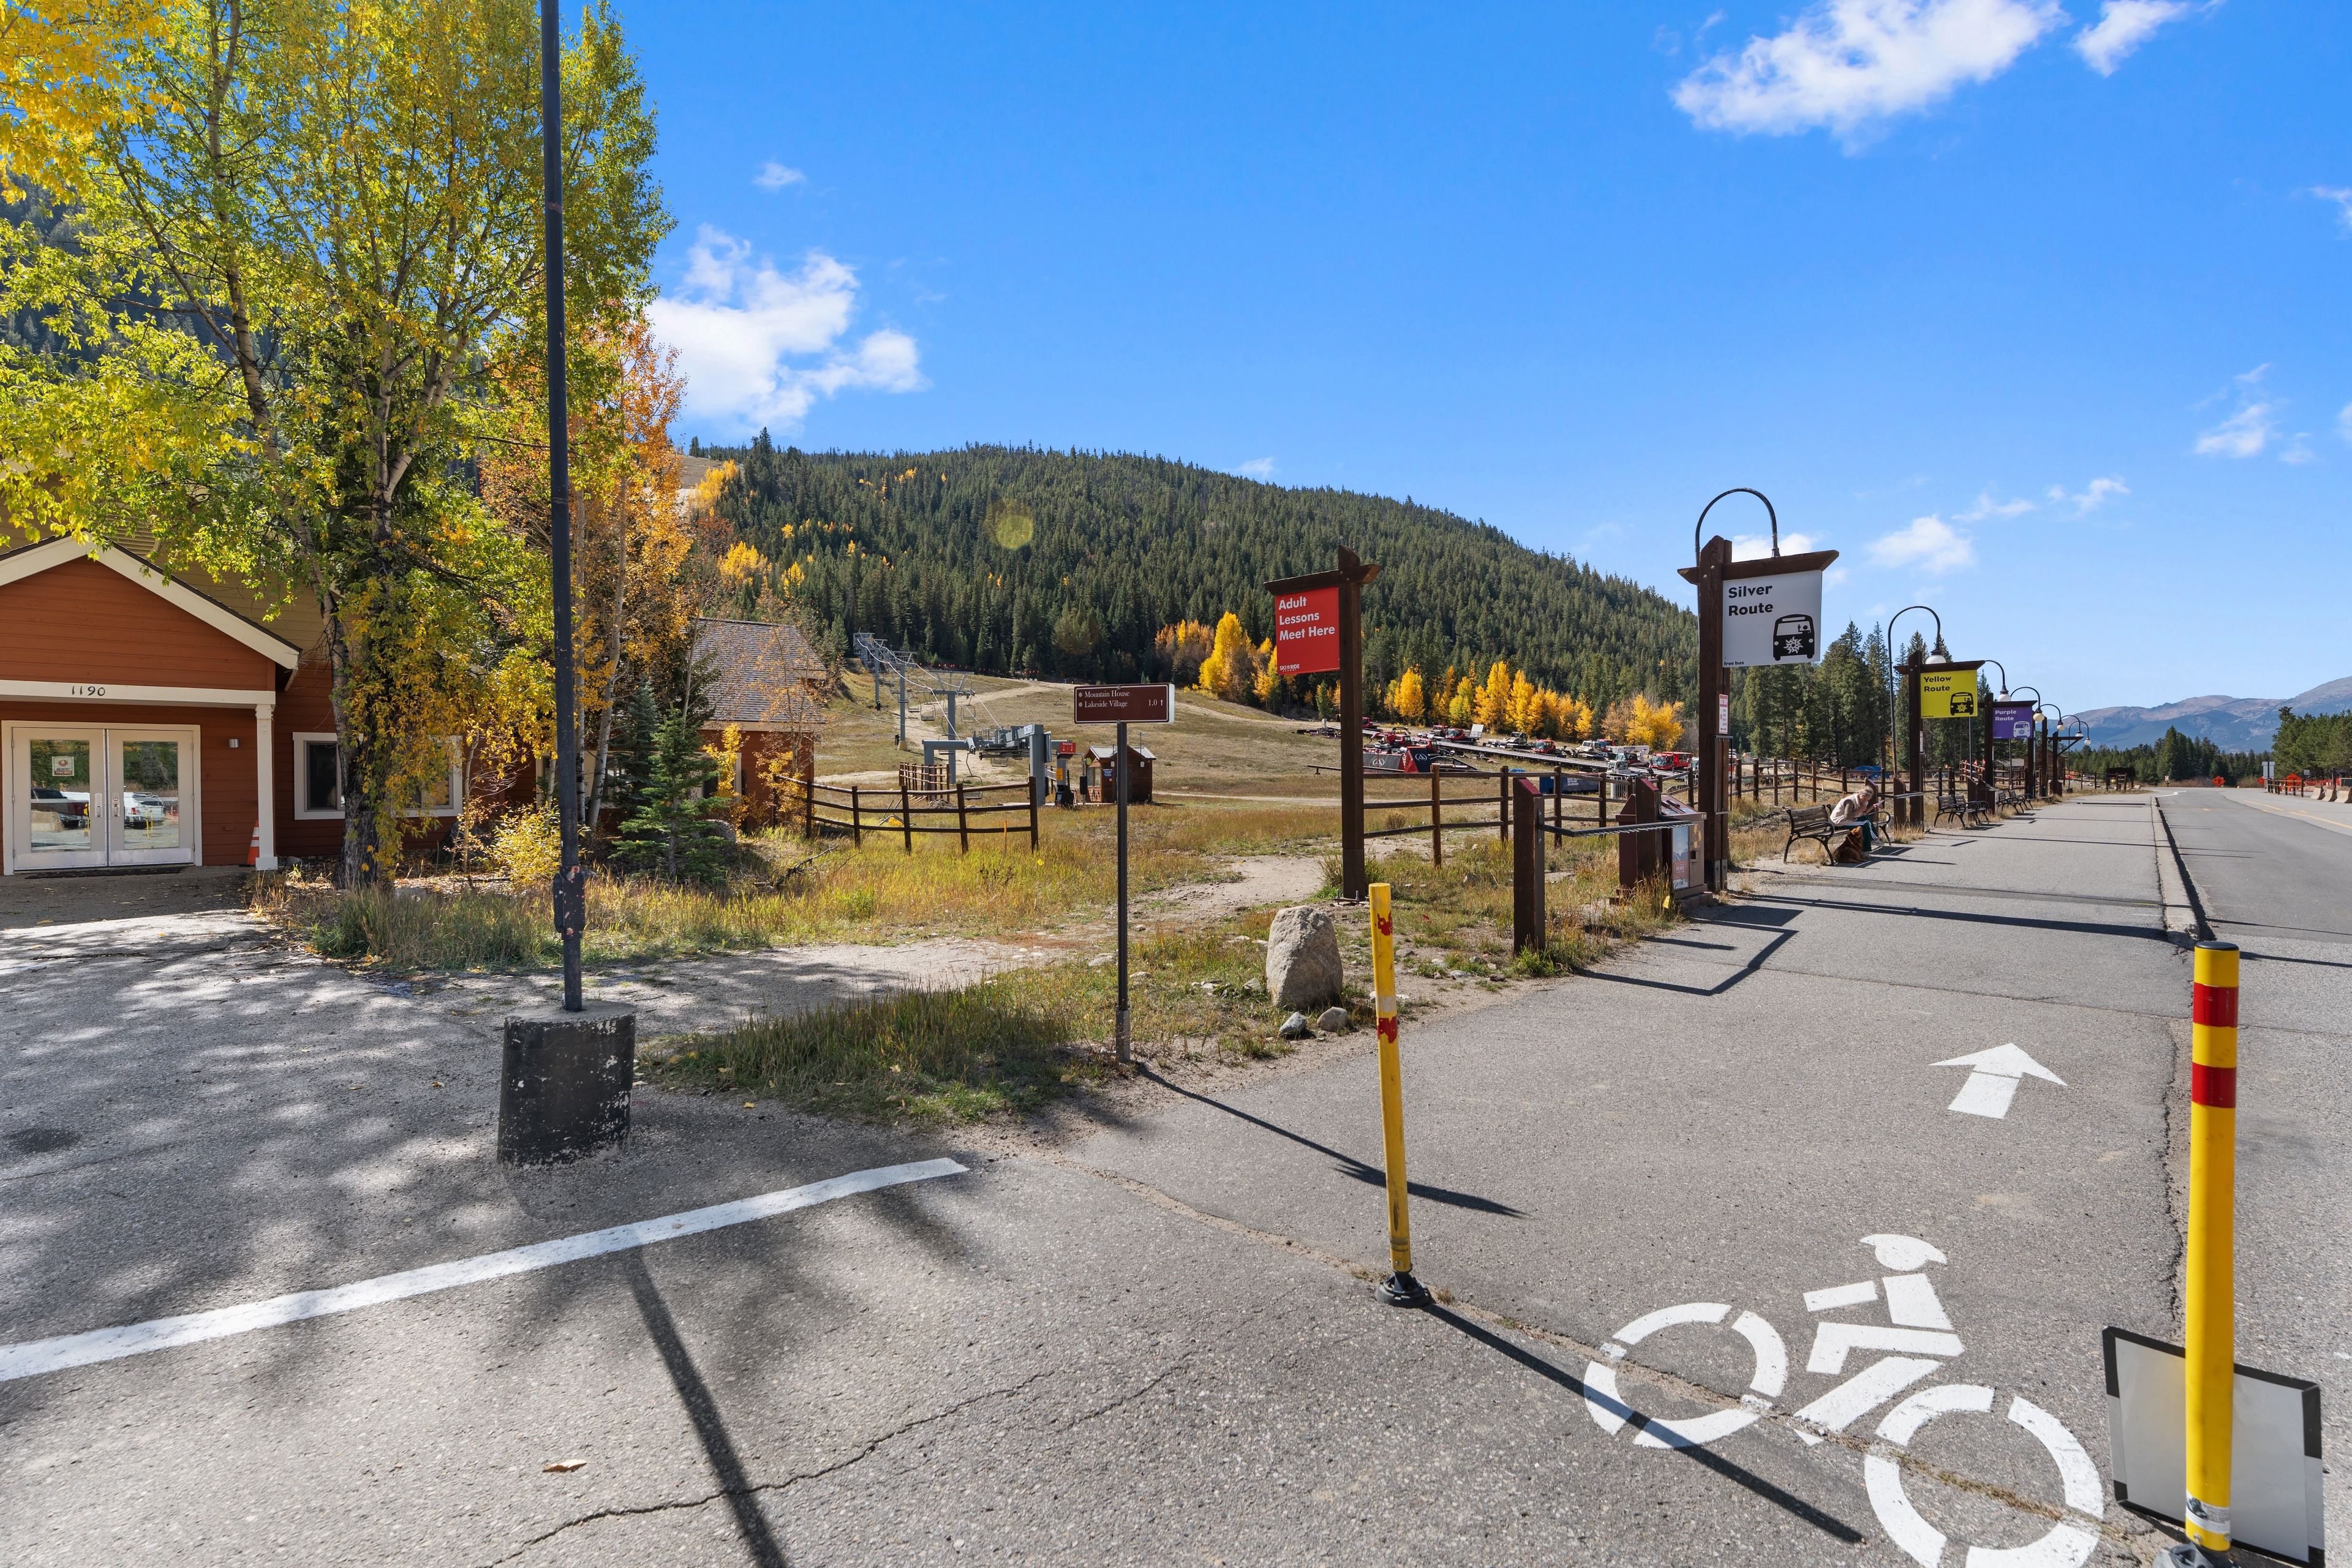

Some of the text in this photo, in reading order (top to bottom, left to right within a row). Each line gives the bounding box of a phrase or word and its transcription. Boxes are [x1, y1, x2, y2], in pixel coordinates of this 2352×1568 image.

[1728, 585, 1773, 598] Silver
[1278, 596, 1306, 610] Adult
[1728, 602, 1773, 616] Route
[1279, 612, 1319, 625] Lessons
[1280, 626, 1335, 641] Meet Here
[72, 685, 105, 696] 1190
